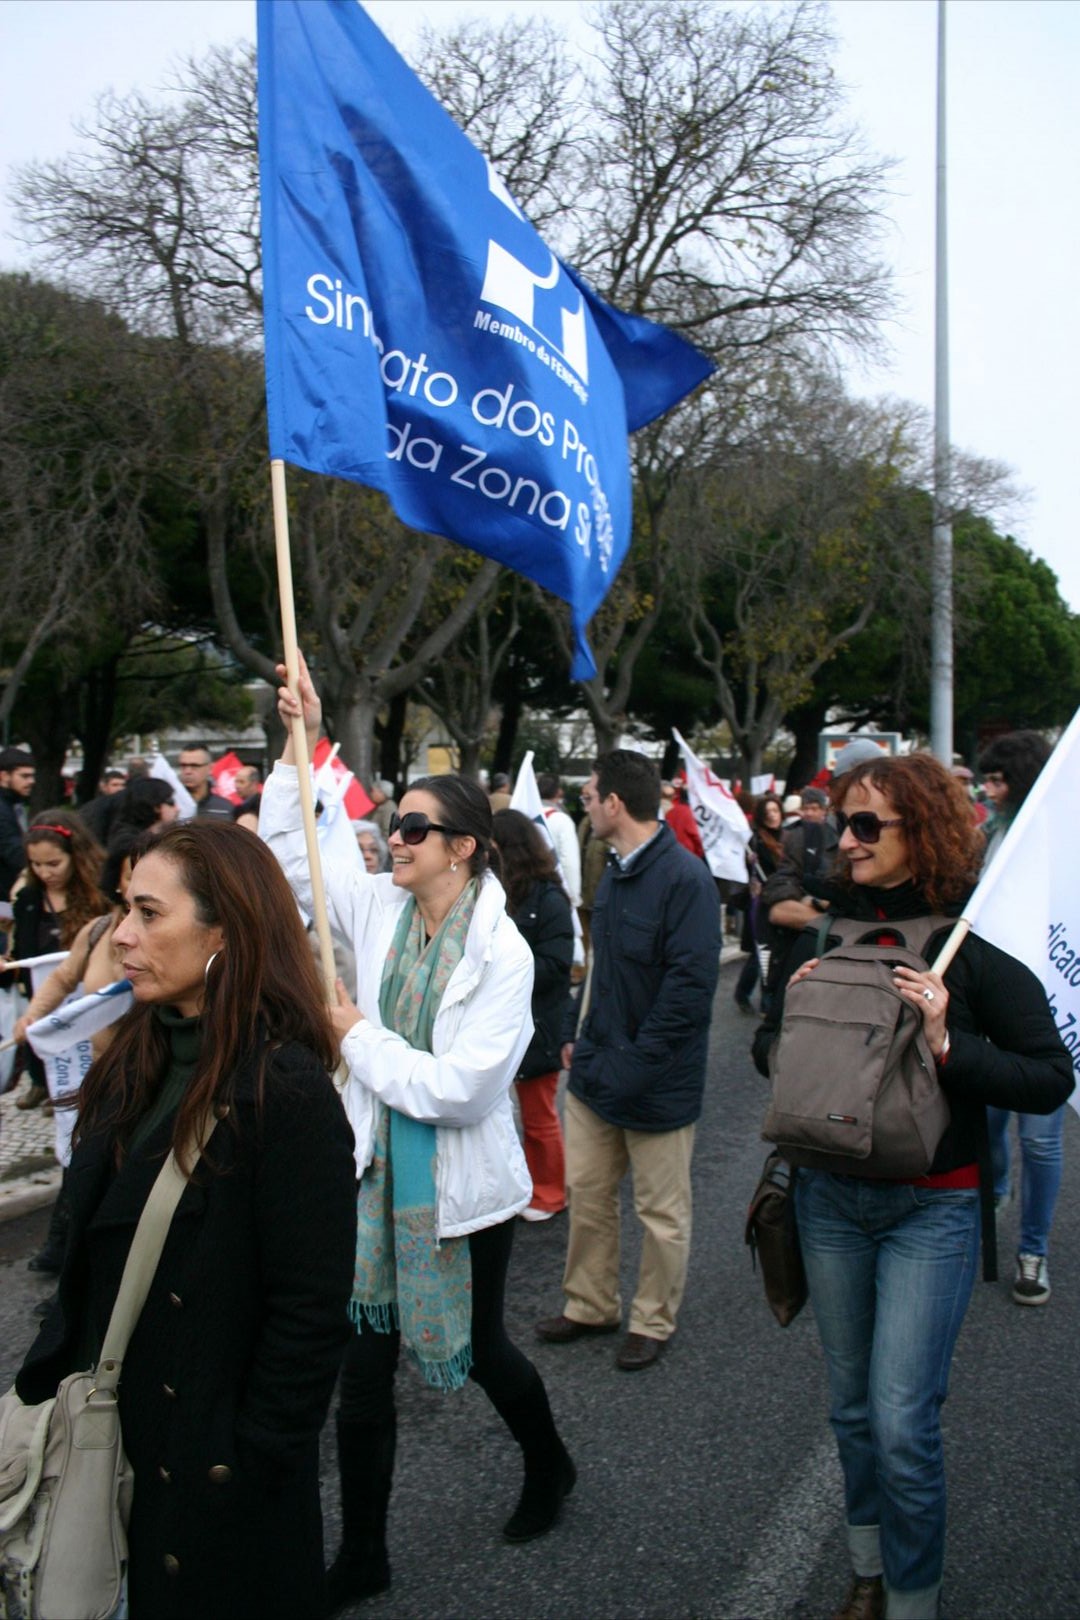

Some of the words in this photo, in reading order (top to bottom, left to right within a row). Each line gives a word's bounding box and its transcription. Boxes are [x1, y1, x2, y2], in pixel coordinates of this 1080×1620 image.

[473, 310, 536, 353] Membro
[471, 383, 556, 446] dos
[450, 443, 572, 531] Zona
[55, 1056, 72, 1087] Zona
